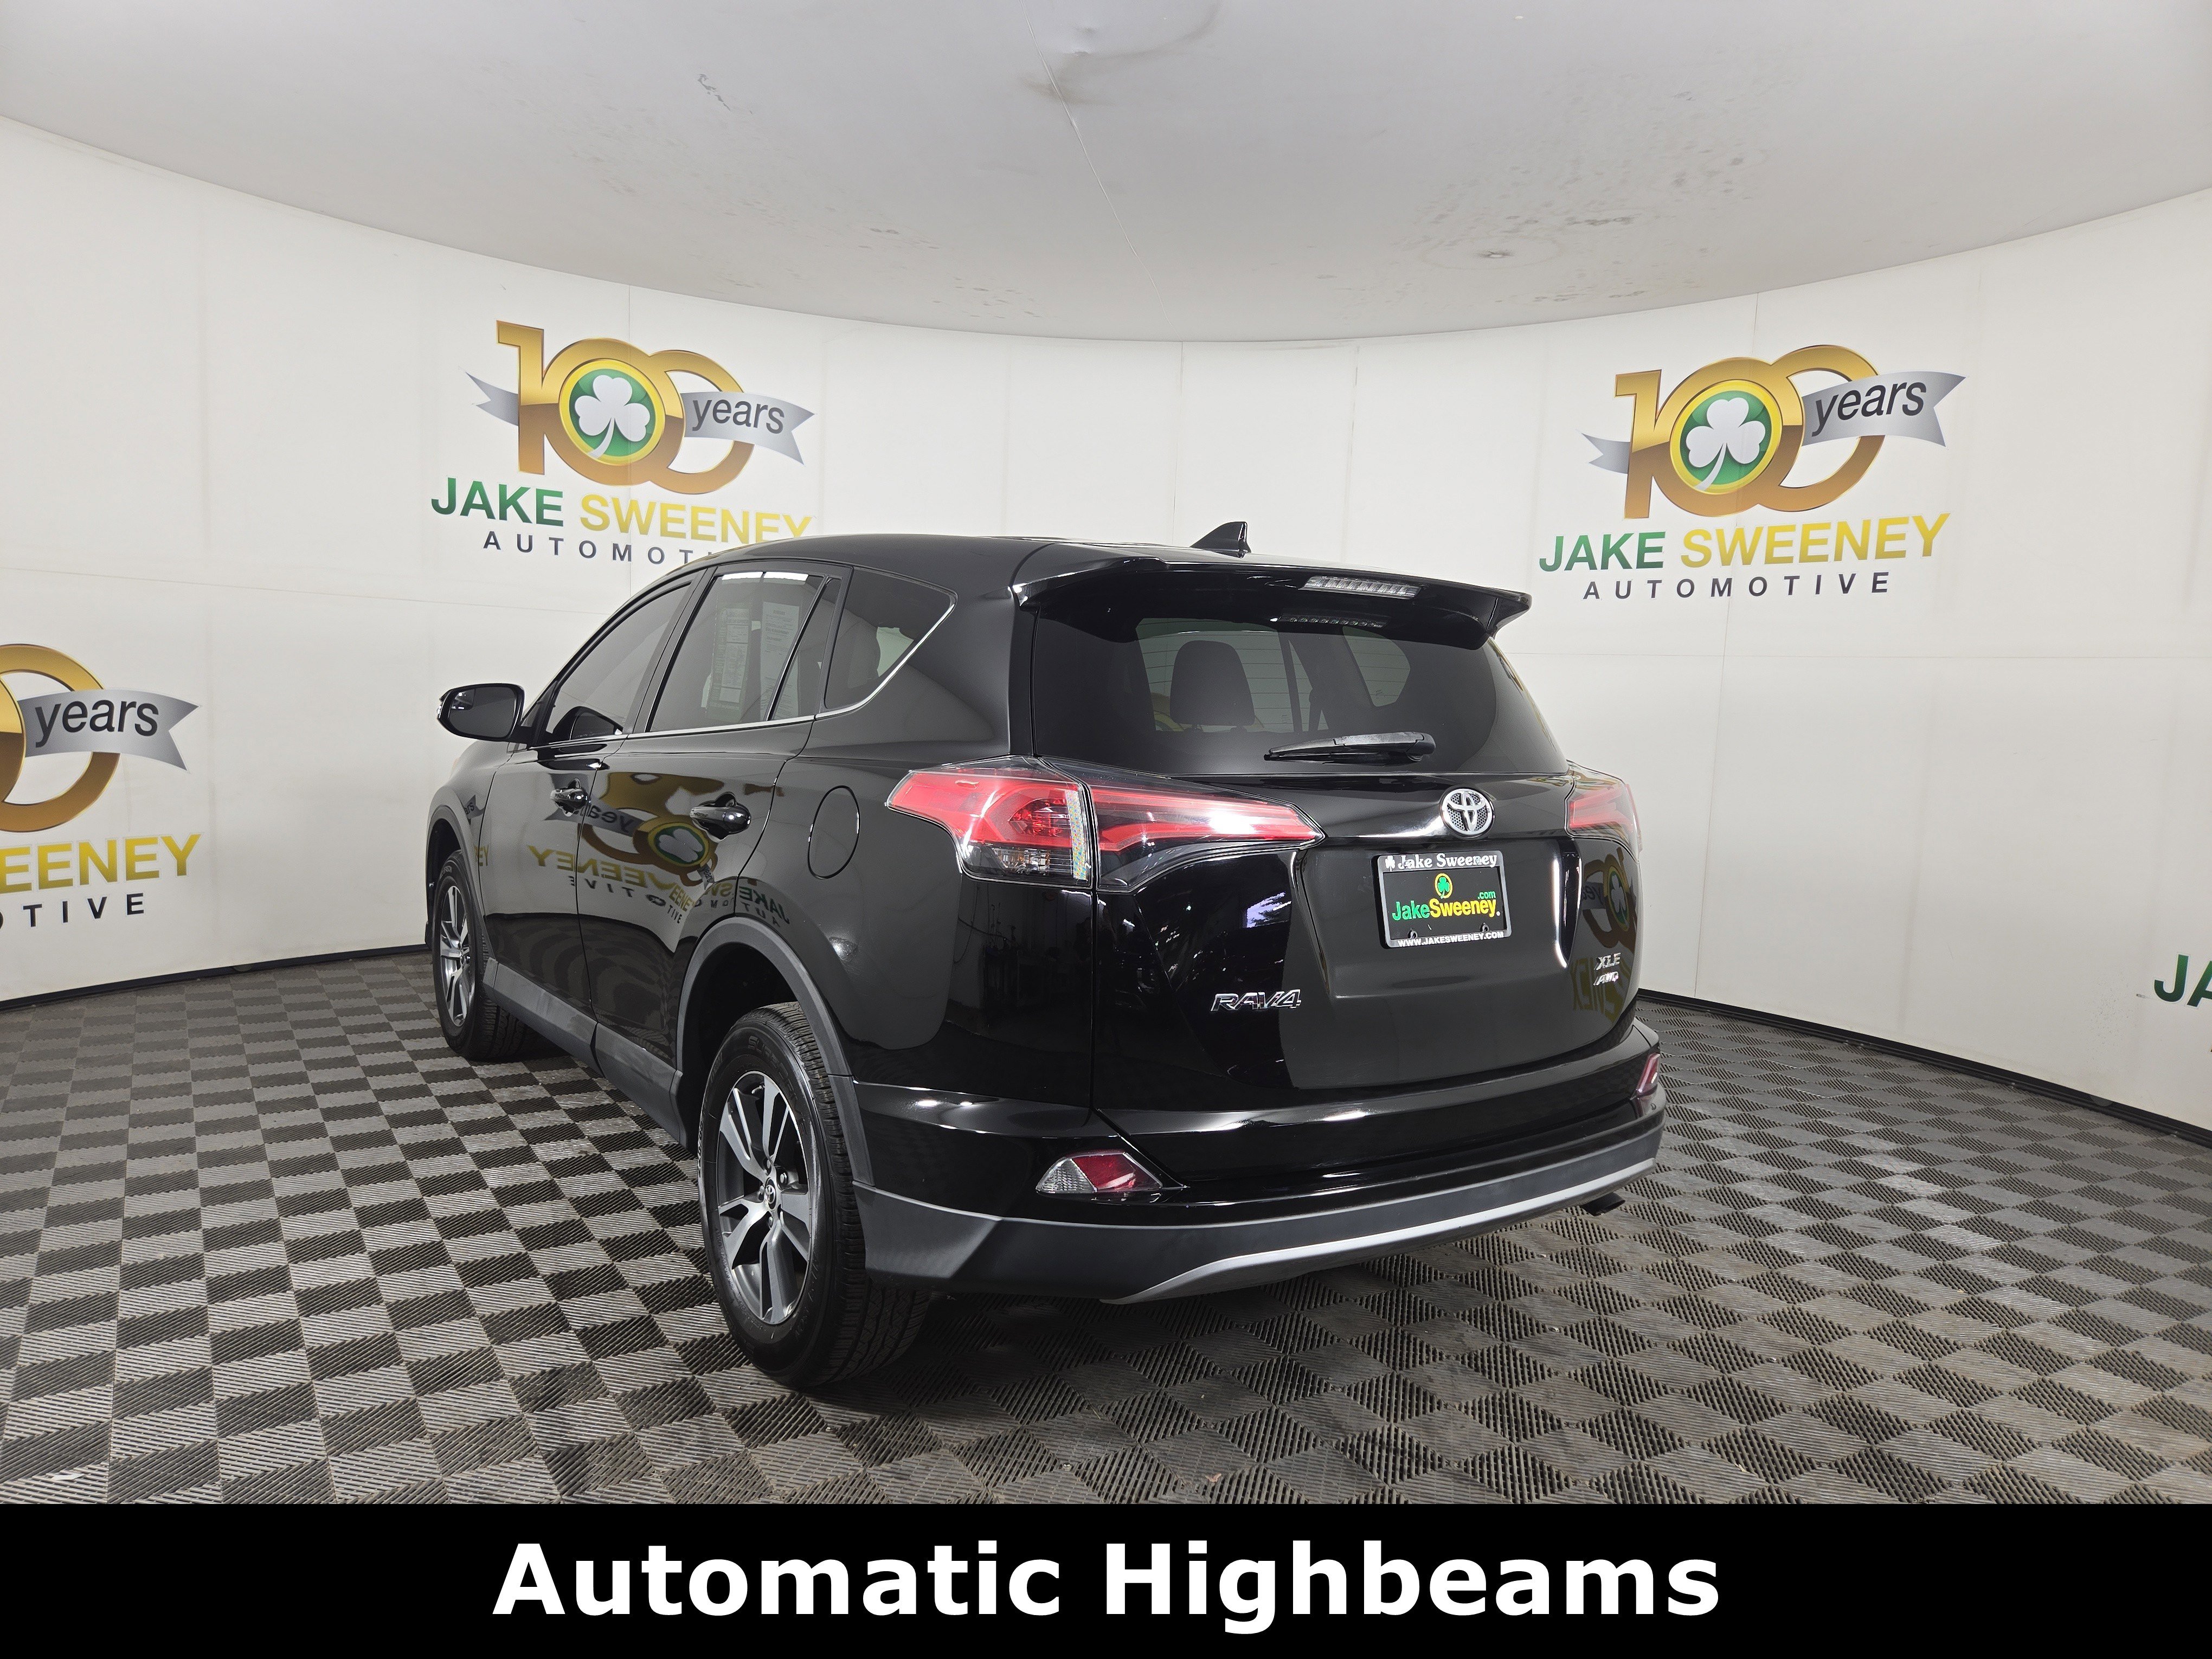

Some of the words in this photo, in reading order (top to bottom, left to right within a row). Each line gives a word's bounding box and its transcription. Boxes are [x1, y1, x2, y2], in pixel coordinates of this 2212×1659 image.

[496, 319, 755, 494] 100
[692, 397, 786, 434] years
[1614, 344, 1887, 519] 100
[1811, 380, 1927, 437] years
[431, 477, 564, 527] JAKE
[580, 494, 812, 544] SWEENEY
[483, 530, 712, 566] AUTOMOT
[1539, 531, 1666, 572] JAKE
[1681, 512, 1951, 568] SWEENEY
[1583, 571, 1890, 600] AUTOMOTIVE
[35, 699, 159, 748] years
[1397, 854, 1433, 869] Jake
[1436, 853, 1497, 868] Sweeney
[0, 892, 144, 928] TIVE
[1477, 891, 1496, 899] .com
[1397, 931, 1504, 947] WWW.JAKESWEENEY.COM
[1596, 953, 1621, 970] XLE
[1594, 971, 1619, 986] AWD
[1210, 989, 1302, 1012] RAV4
